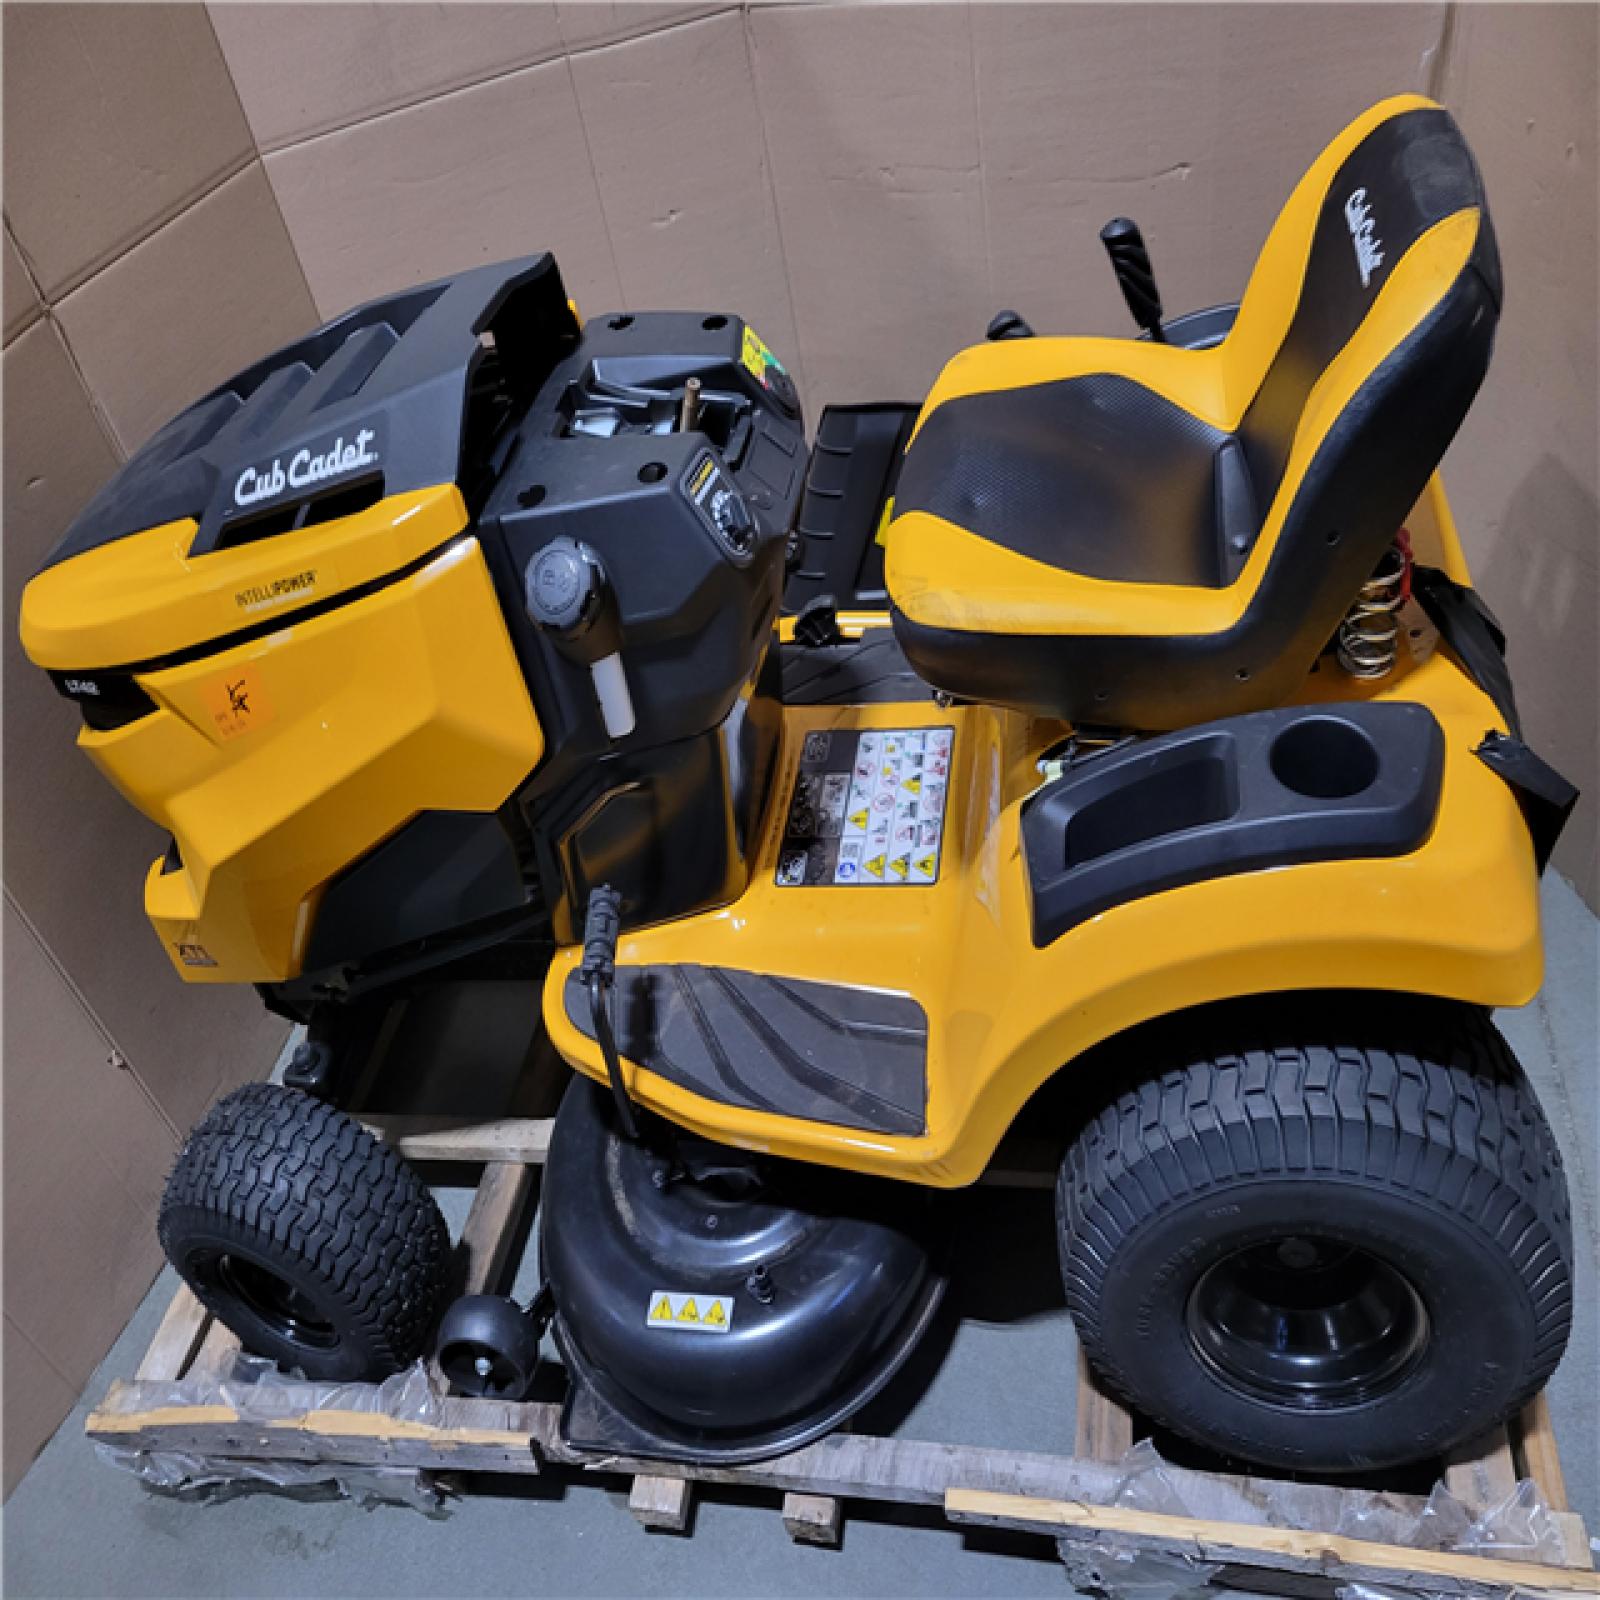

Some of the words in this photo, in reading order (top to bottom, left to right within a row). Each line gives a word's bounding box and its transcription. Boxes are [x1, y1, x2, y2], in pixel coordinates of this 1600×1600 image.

[234, 459, 286, 506] Cub
[287, 429, 376, 488] Cadet
[235, 570, 317, 607] INTELLIPOWER
